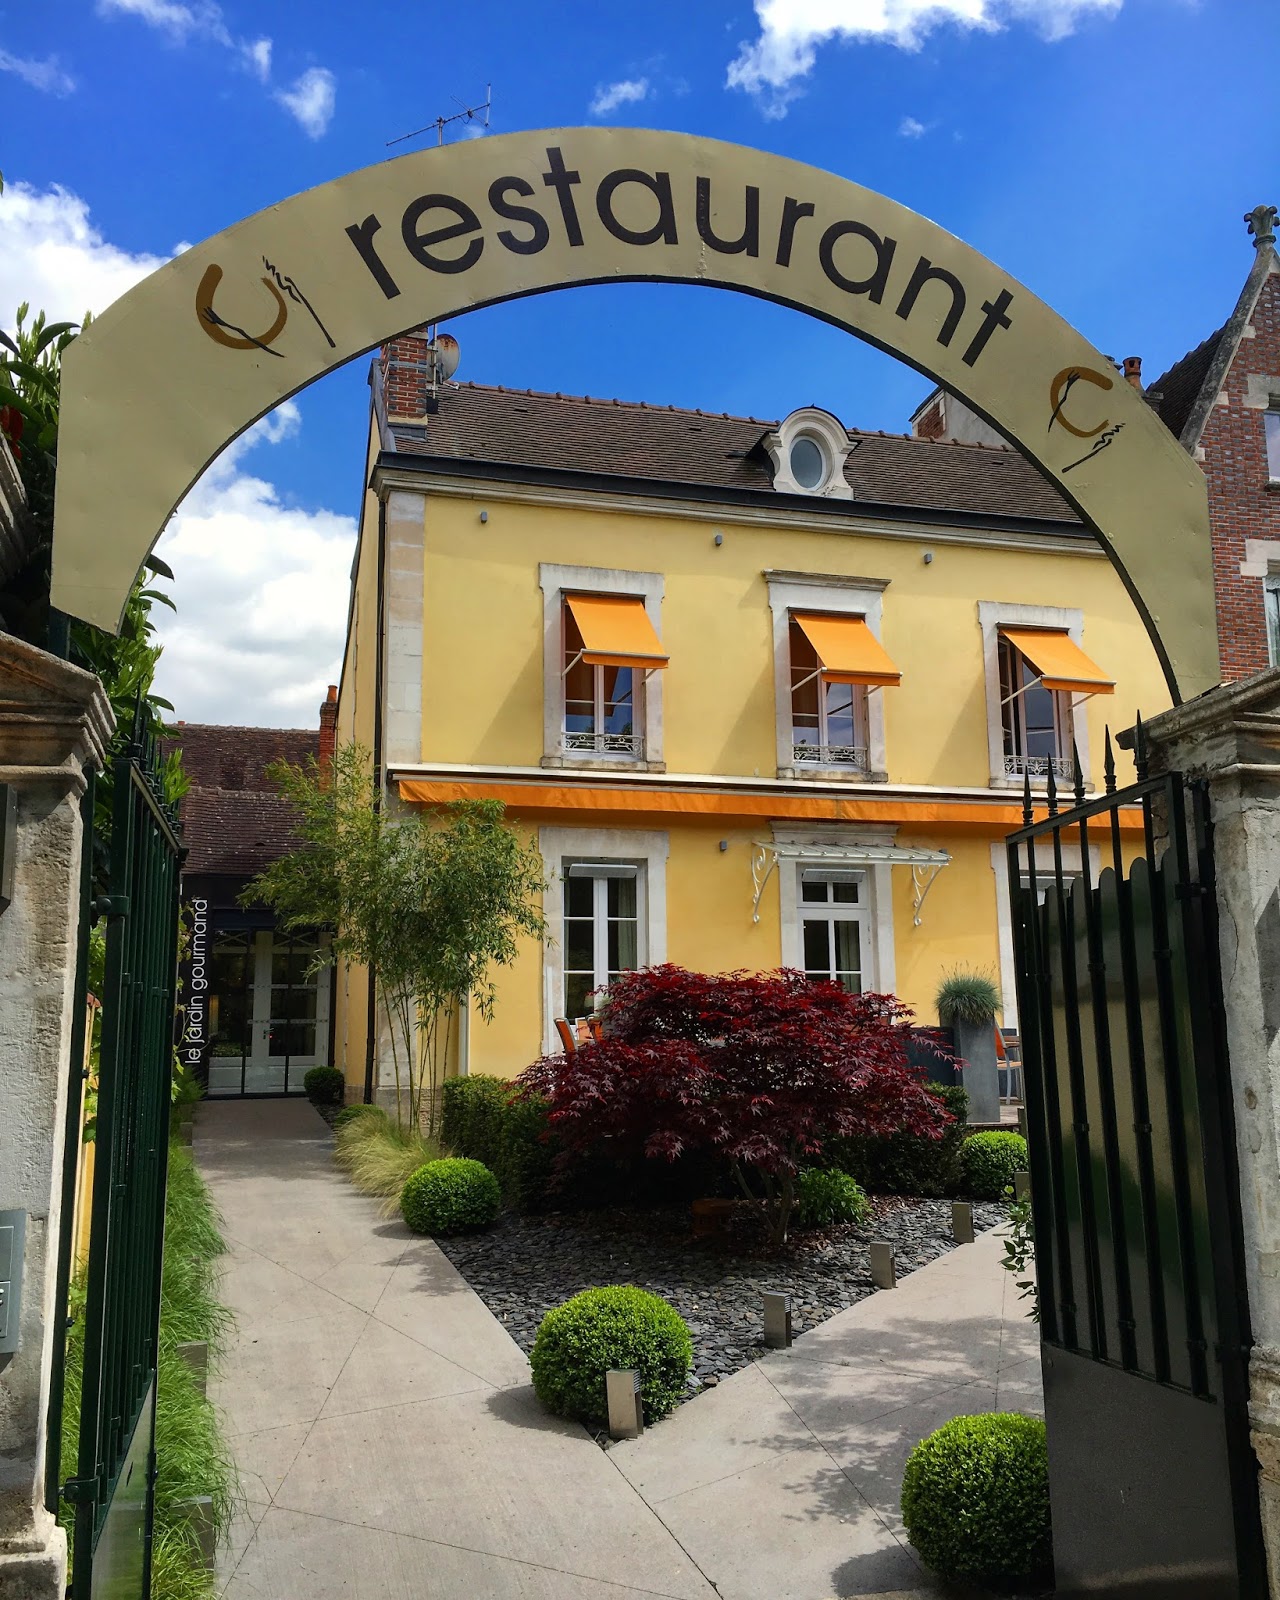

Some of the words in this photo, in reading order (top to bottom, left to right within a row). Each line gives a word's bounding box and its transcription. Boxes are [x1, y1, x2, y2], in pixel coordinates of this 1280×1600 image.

[345, 147, 1014, 368] restaurant
[191, 899, 208, 990] gourmand
[187, 995, 205, 1043] jardin
[185, 1048, 200, 1064] le
